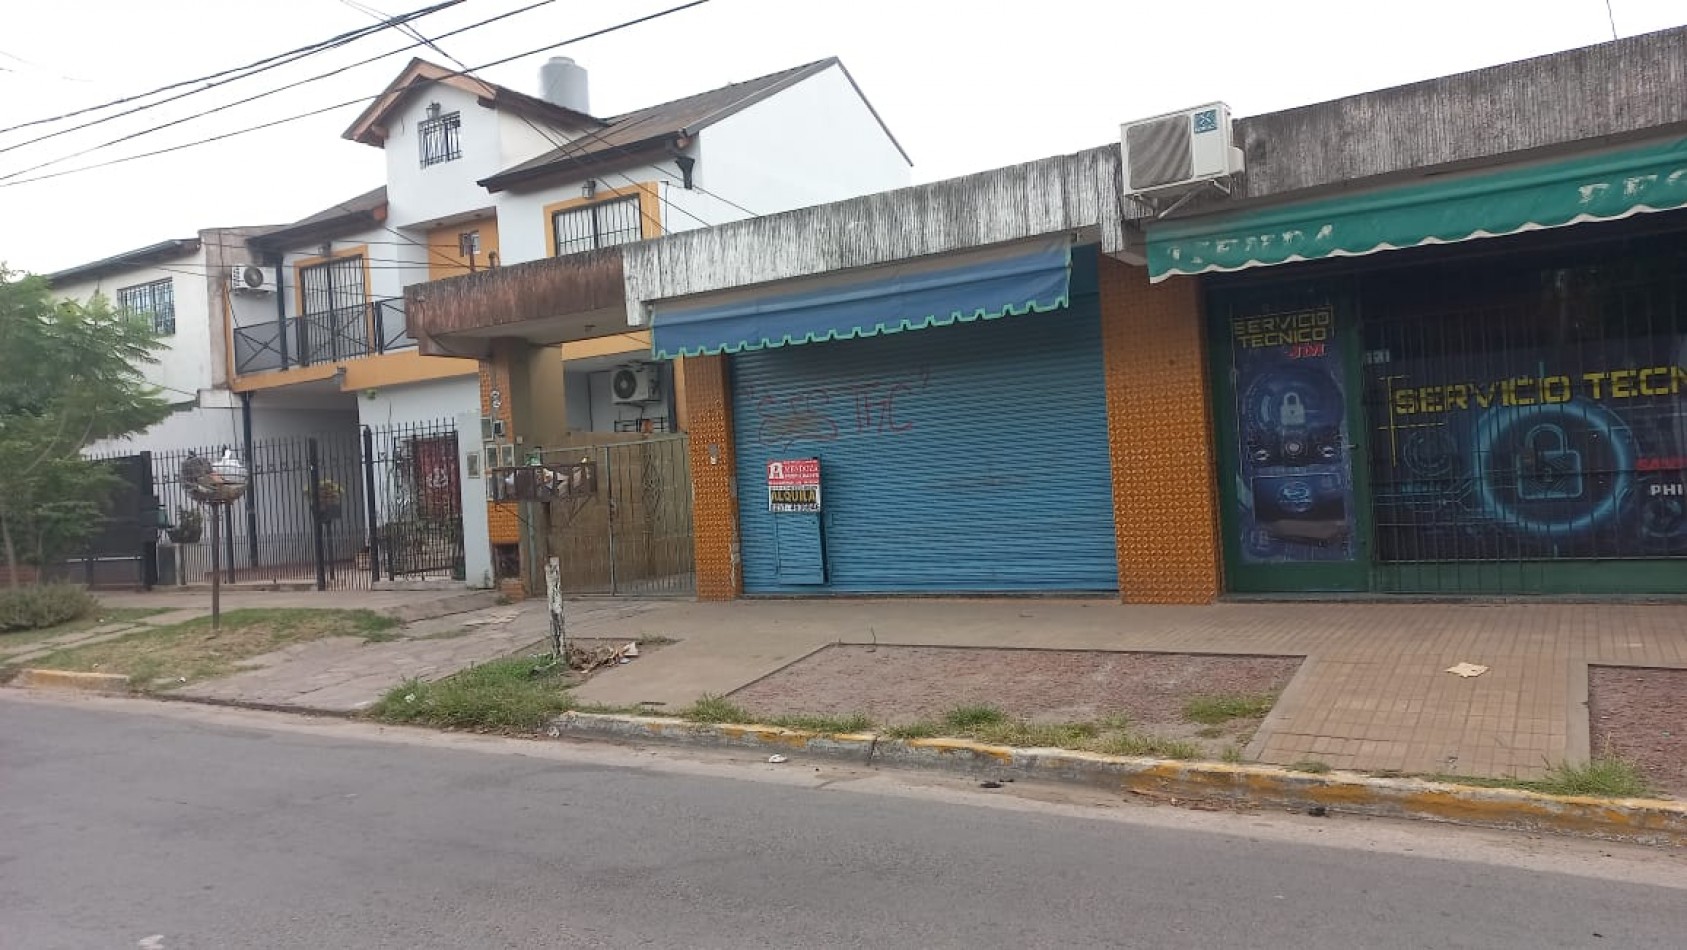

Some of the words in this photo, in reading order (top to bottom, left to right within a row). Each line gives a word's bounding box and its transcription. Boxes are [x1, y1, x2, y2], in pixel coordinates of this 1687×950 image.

[1234, 311, 1329, 335] SERVICIO
[1237, 327, 1326, 348] TECNICO
[1396, 375, 1572, 414] SERVICIO
[771, 490, 815, 503] ALQUILA
[1650, 483, 1683, 496] PHI
